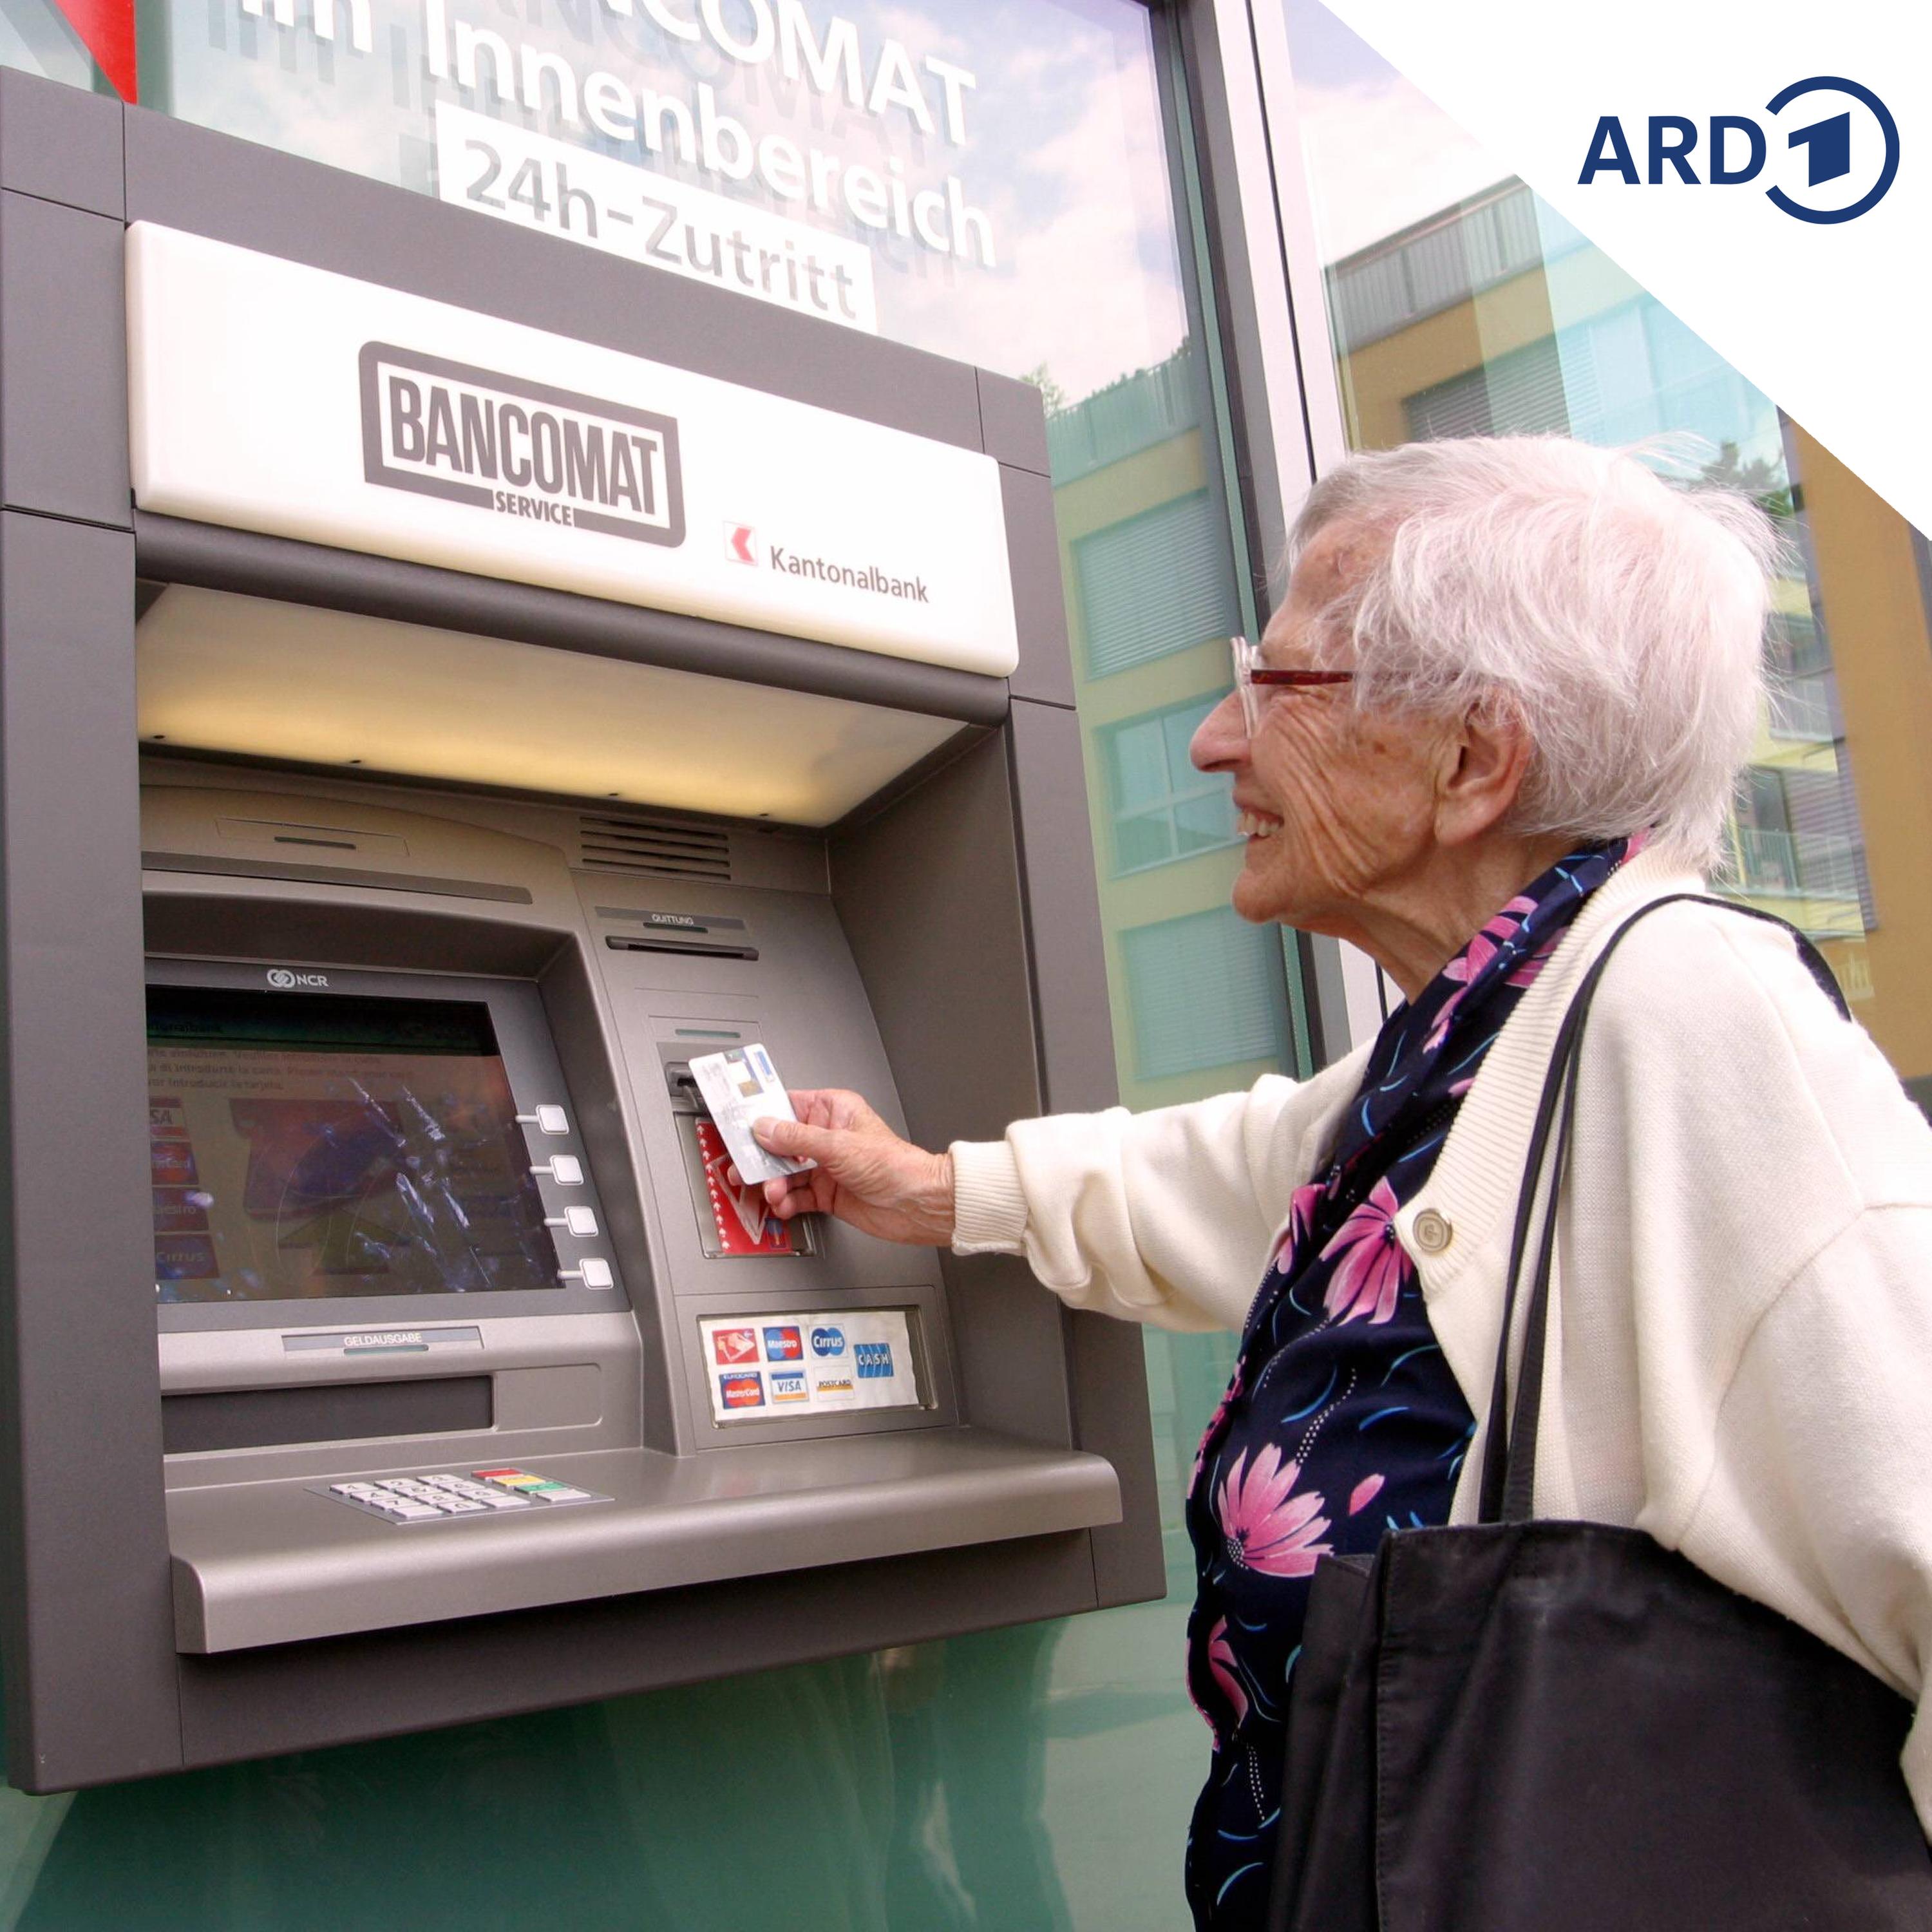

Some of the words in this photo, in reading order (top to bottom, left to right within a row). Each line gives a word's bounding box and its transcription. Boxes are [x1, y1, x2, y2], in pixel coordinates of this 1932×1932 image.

[603, 0, 976, 147] COMAT
[426, 0, 996, 267] Innenbereich
[464, 138, 857, 320] 24h-Zutritt
[389, 375, 658, 515] BANCOMAT
[494, 491, 573, 527] SERVICE
[770, 545, 929, 603] Kantonalbank
[296, 974, 329, 987] NCR
[343, 1332, 423, 1347] GELDAUSGABE
[813, 1336, 843, 1348] Cirrus
[858, 1353, 889, 1366] CASH
[777, 1380, 802, 1392] VISA
[818, 1379, 852, 1388] POSTCARD
